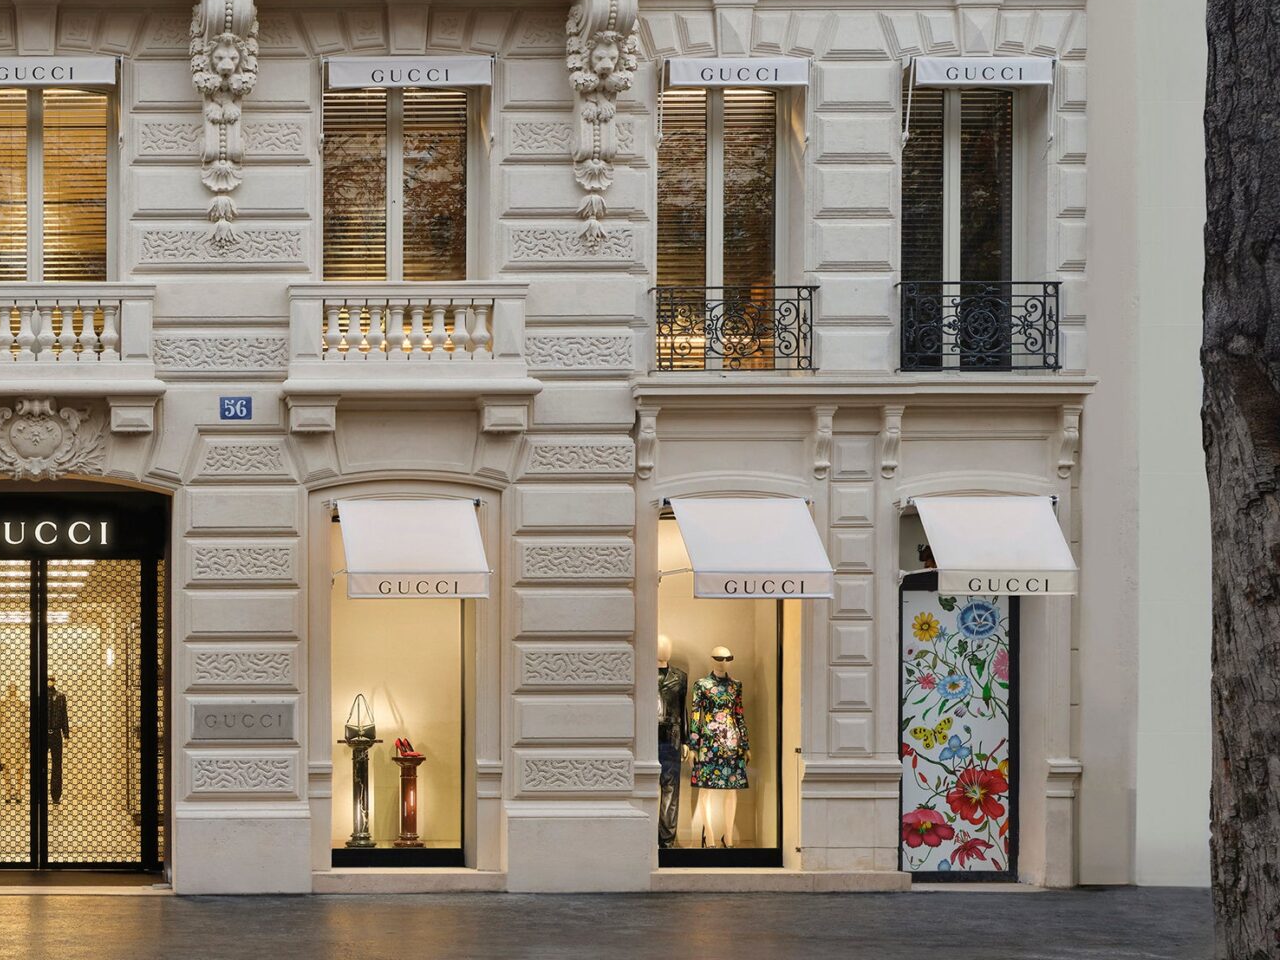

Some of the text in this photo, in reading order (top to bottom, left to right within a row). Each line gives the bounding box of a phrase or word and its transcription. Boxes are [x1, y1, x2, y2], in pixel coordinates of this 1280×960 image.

[371, 68, 450, 83] GUCCI
[700, 68, 778, 81] GUCCI
[946, 67, 1023, 81] GUCCI
[225, 399, 248, 417] 56
[378, 580, 458, 595] GUCCI
[724, 580, 804, 594] GUCCI
[968, 577, 1049, 593] GUCCI
[205, 714, 282, 729] GUCCI
